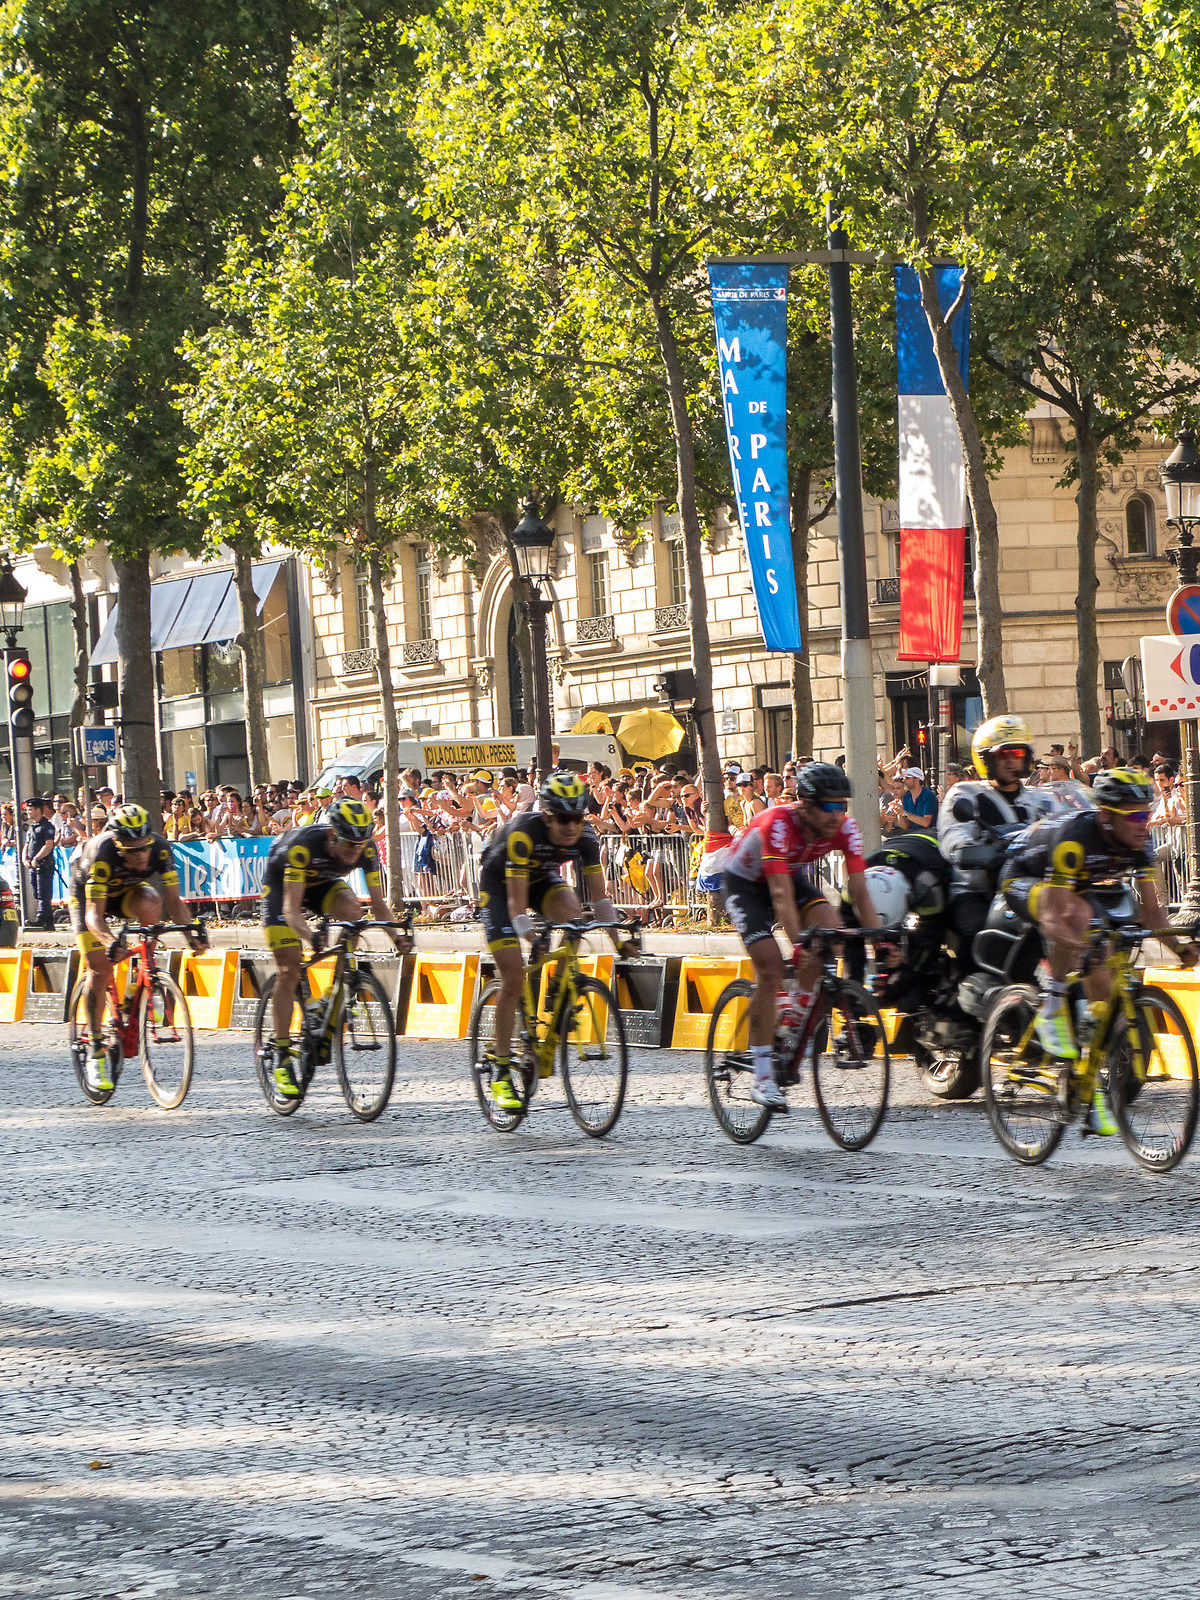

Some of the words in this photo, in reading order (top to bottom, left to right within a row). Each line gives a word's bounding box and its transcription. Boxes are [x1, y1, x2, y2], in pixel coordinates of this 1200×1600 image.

[748, 401, 768, 413] DE
[719, 337, 750, 528] MAIRIE
[750, 433, 779, 595] PARIS
[444, 745, 486, 765] COLLECTION
[488, 744, 517, 763] PRESSE
[608, 743, 616, 755] 8
[184, 856, 208, 898] Le
